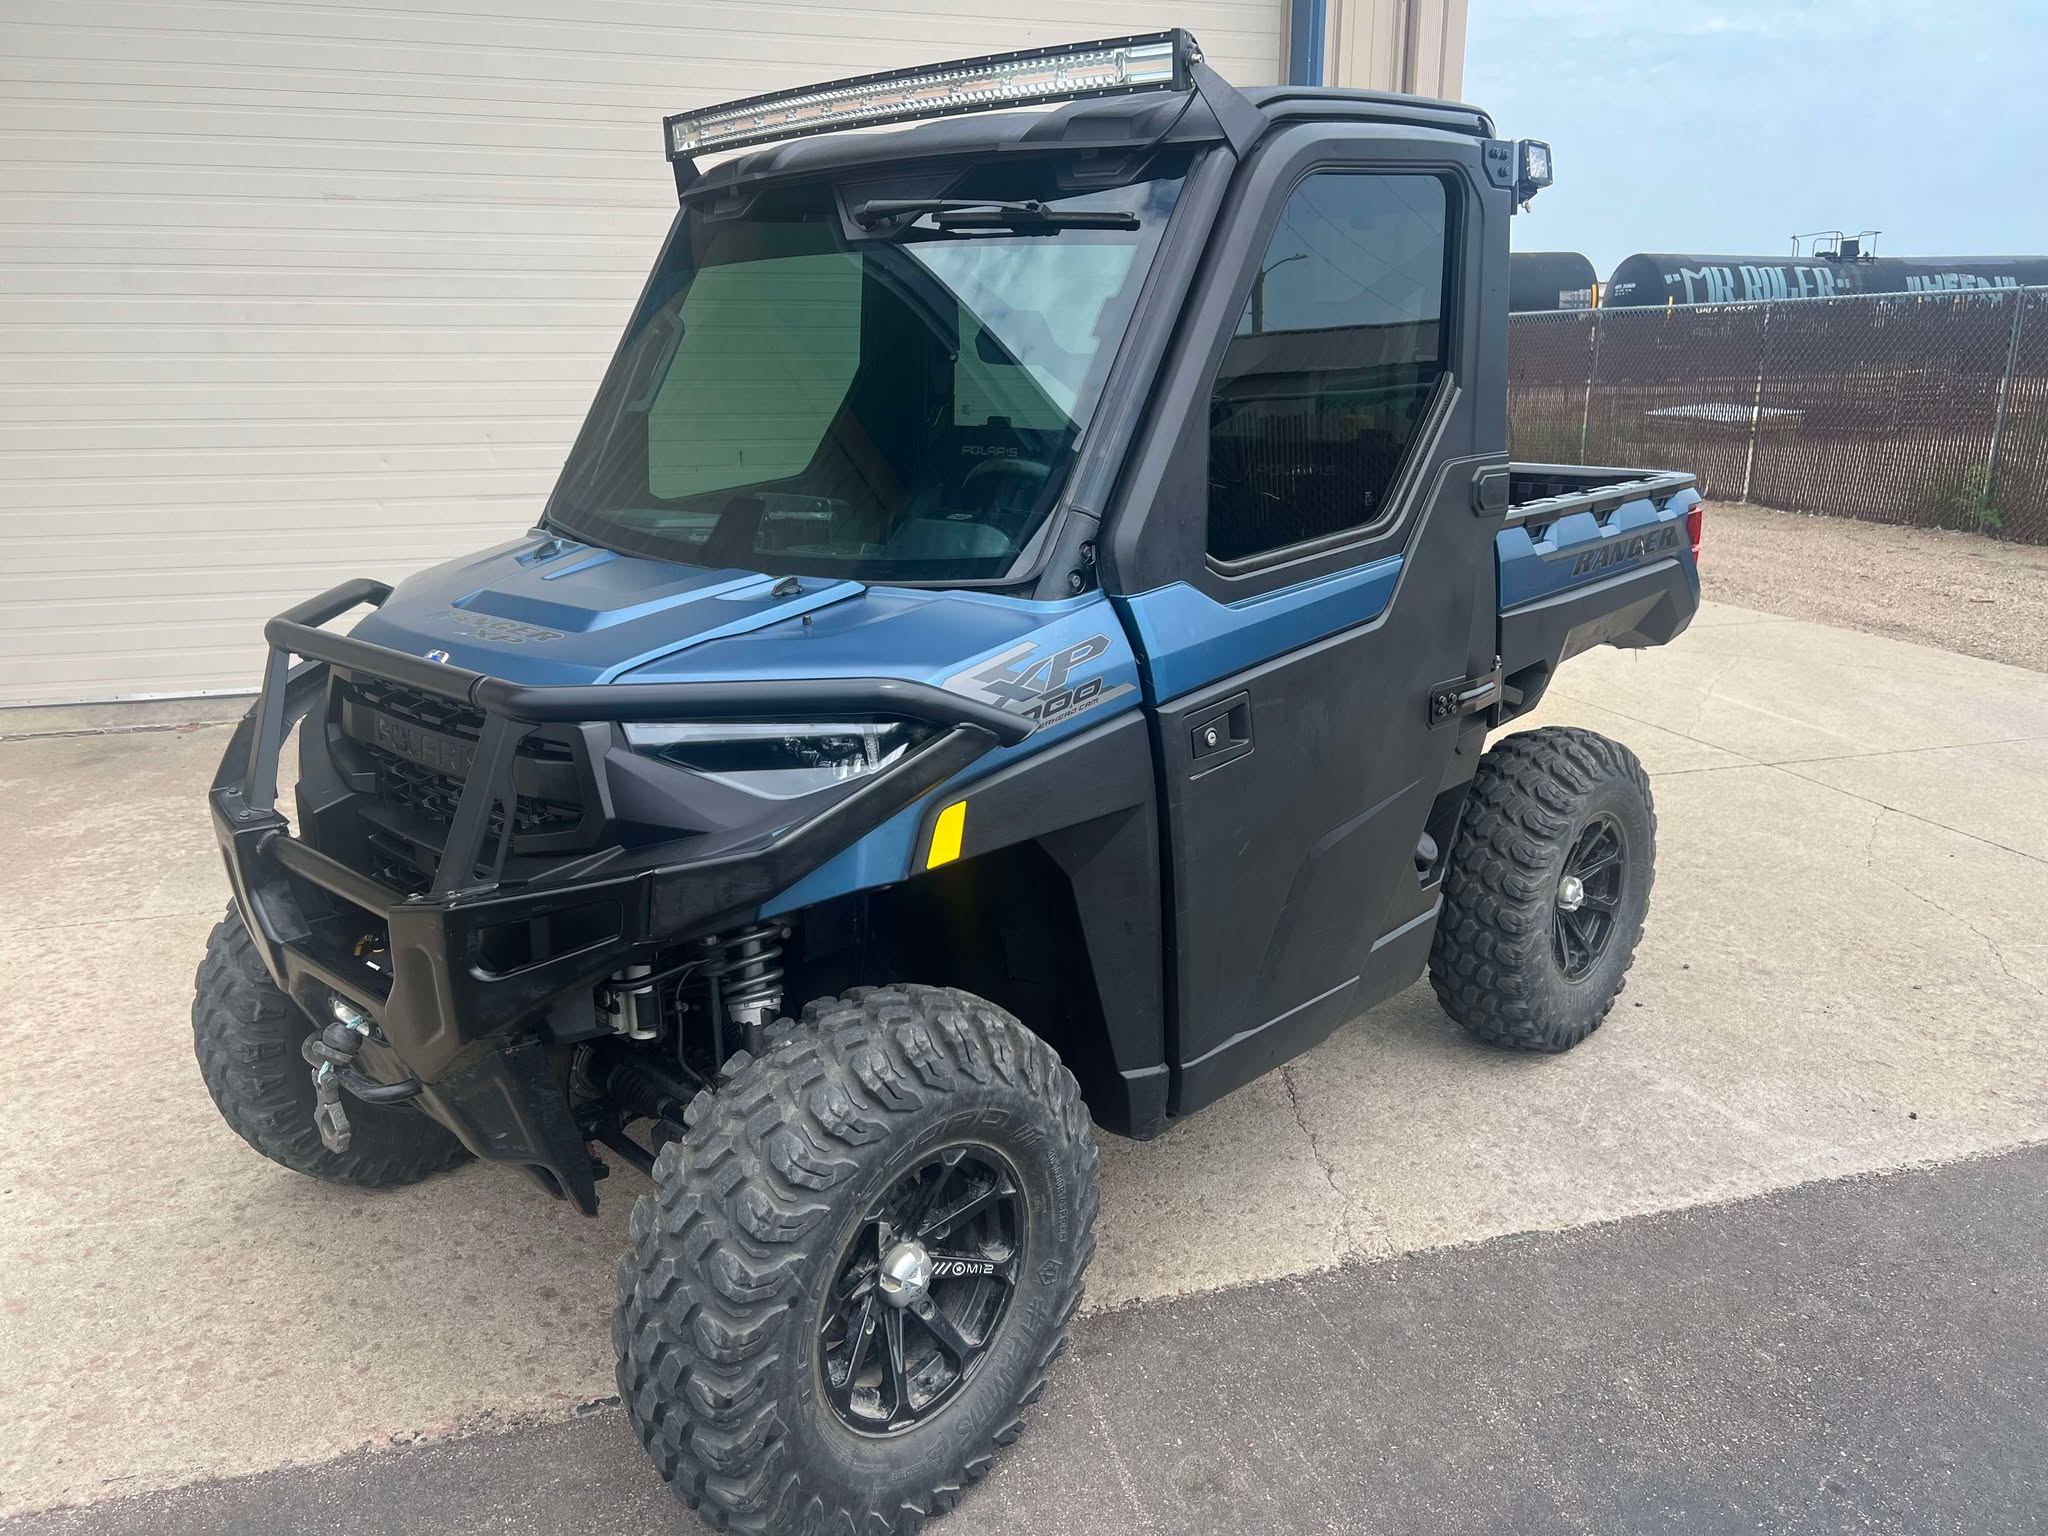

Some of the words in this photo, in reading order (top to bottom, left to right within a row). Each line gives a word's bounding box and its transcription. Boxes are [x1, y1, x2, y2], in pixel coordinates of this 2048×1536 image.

[961, 445, 1018, 457] POLARIS
[1572, 525, 1680, 576] RANGER
[1038, 707, 1078, 730] ERHEAD
[1078, 697, 1099, 712] CAM
